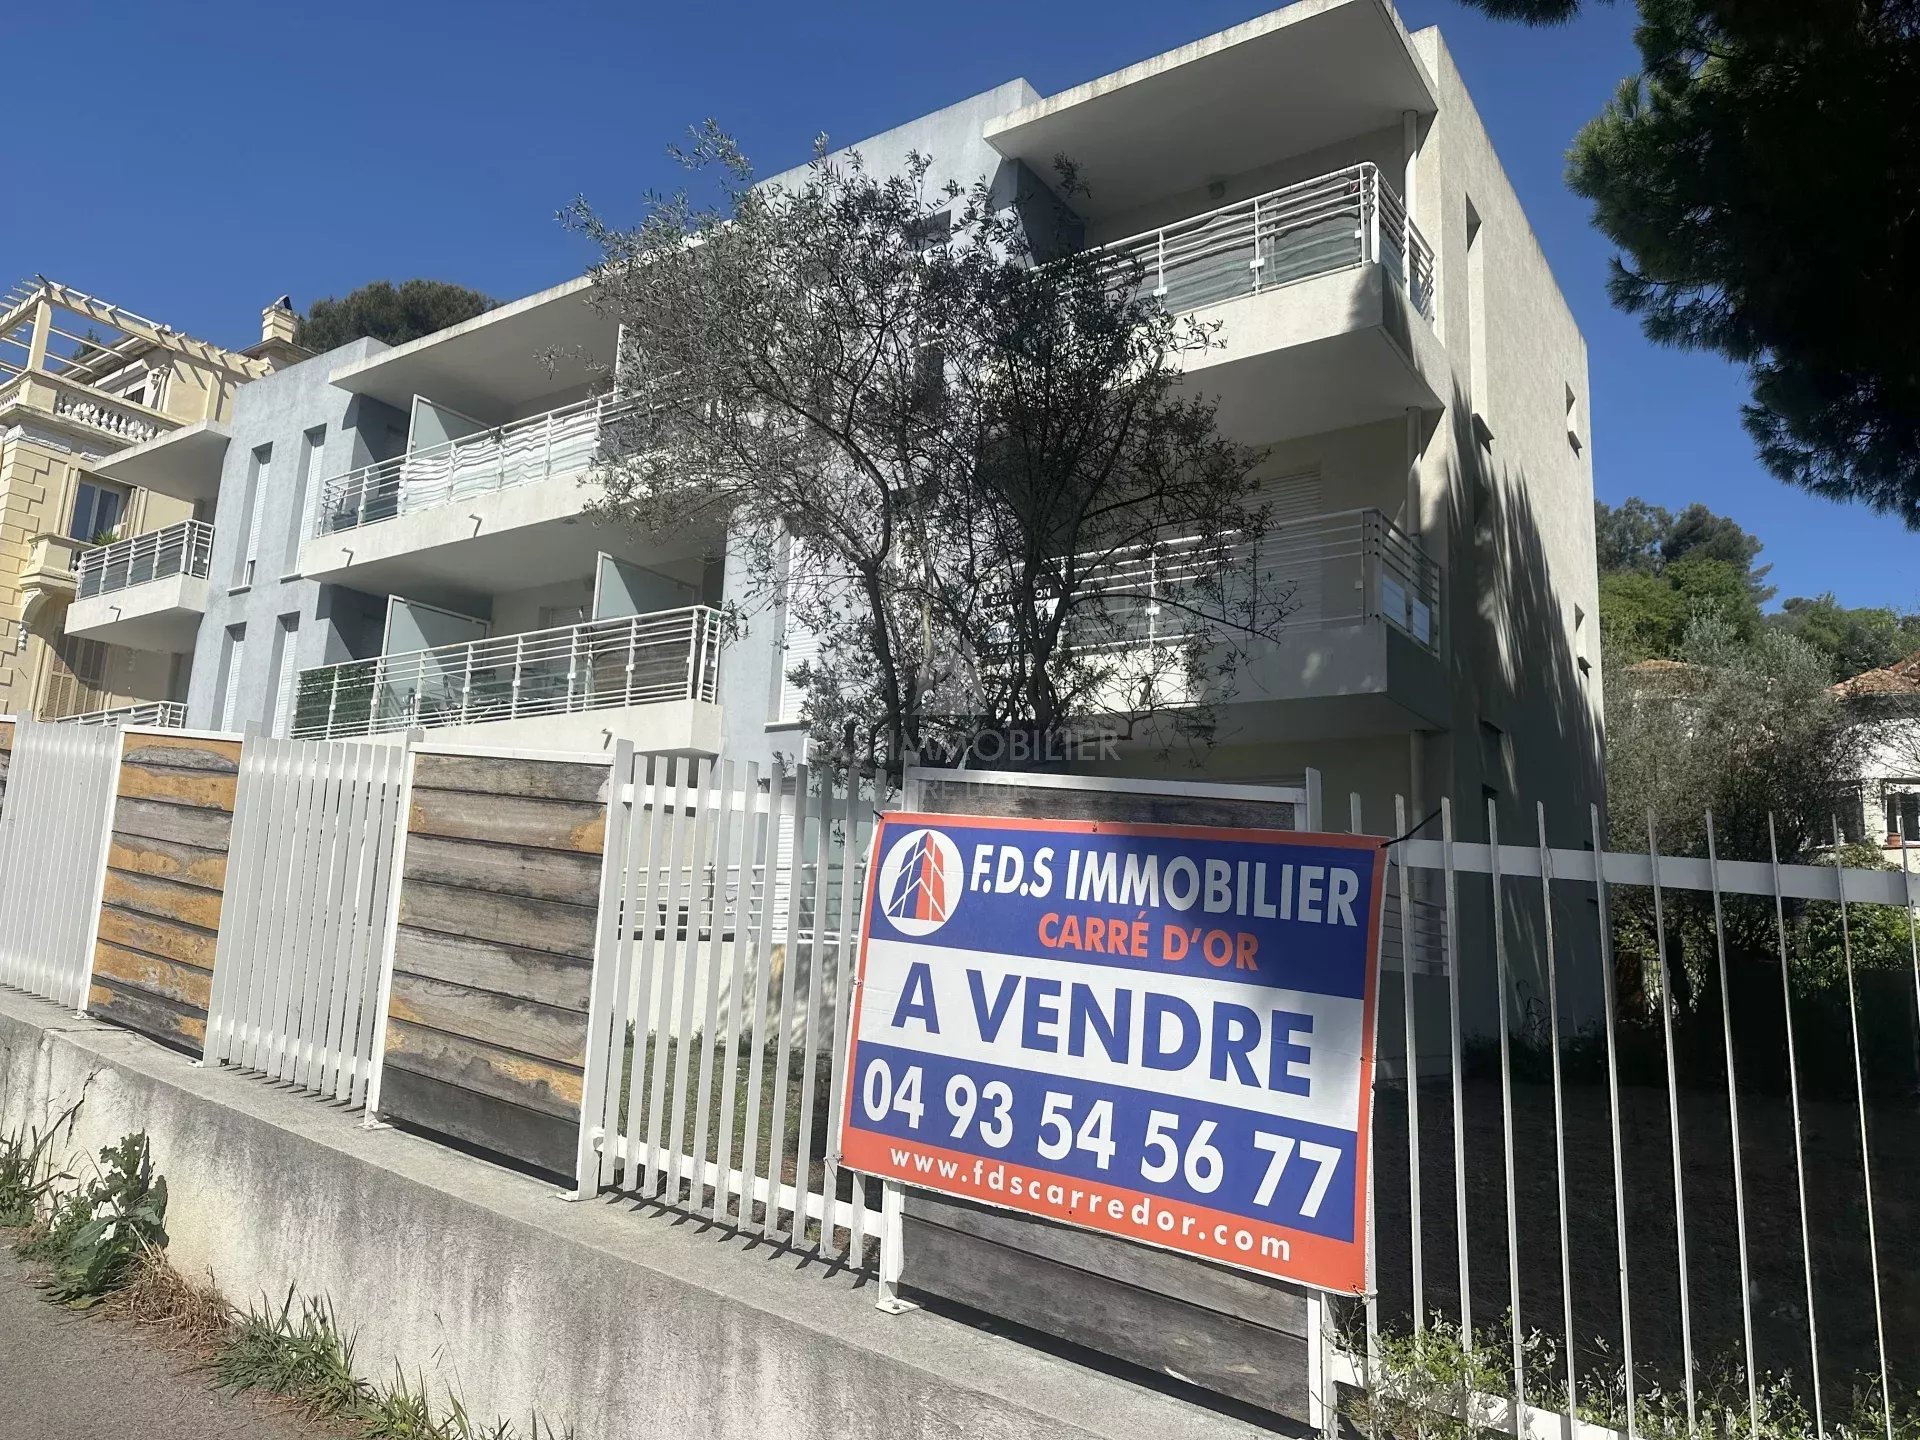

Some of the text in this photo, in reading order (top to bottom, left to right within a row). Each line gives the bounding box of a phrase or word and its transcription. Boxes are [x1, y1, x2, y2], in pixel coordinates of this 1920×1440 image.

[969, 843, 1359, 927] F.D.S IMMOBILIER
[1038, 912, 1259, 971] CARRÉ D'OR
[891, 962, 1314, 1097] A VENDRE
[862, 1058, 1342, 1219] 04 93 54 56 77
[889, 1147, 1291, 1262] www.fdscarredor.com
